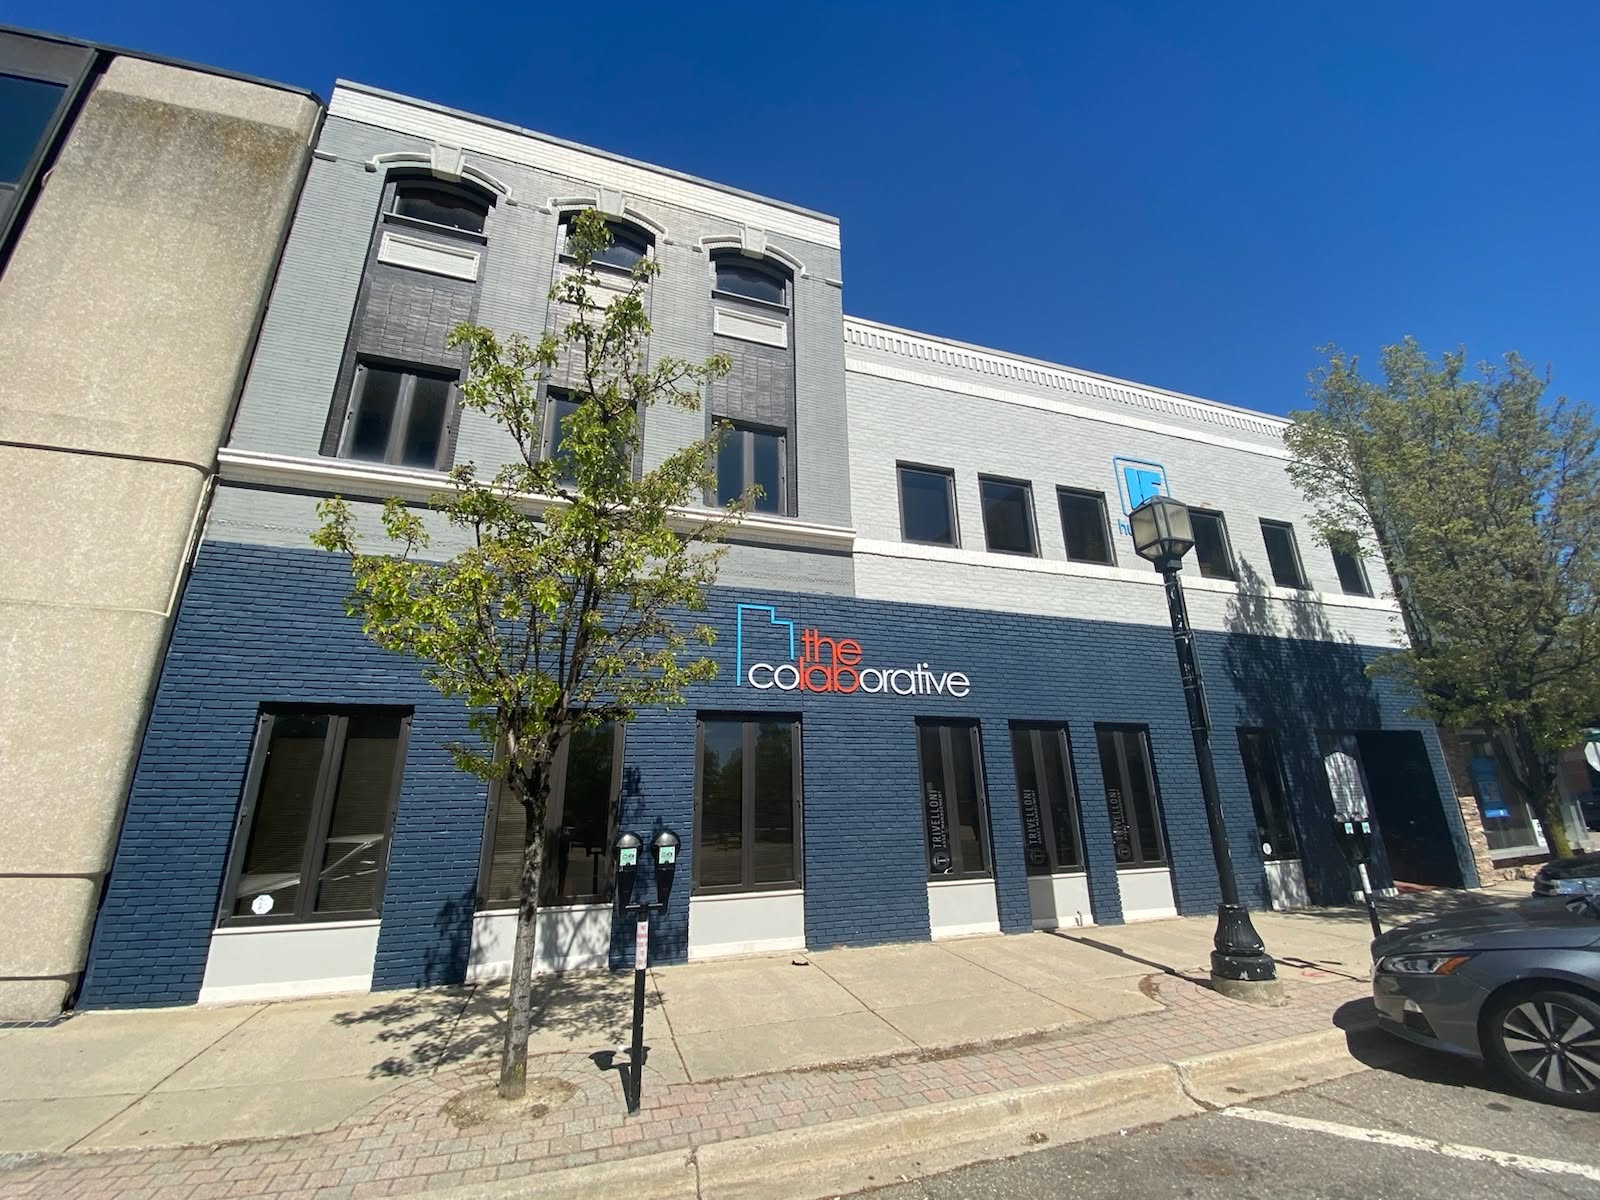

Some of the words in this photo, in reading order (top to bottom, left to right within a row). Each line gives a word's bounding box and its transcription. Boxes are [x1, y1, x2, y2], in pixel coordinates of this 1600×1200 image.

[801, 628, 862, 666] the
[928, 789, 942, 849] TRIVELLONI
[1023, 789, 1038, 845] TRIVELLONI
